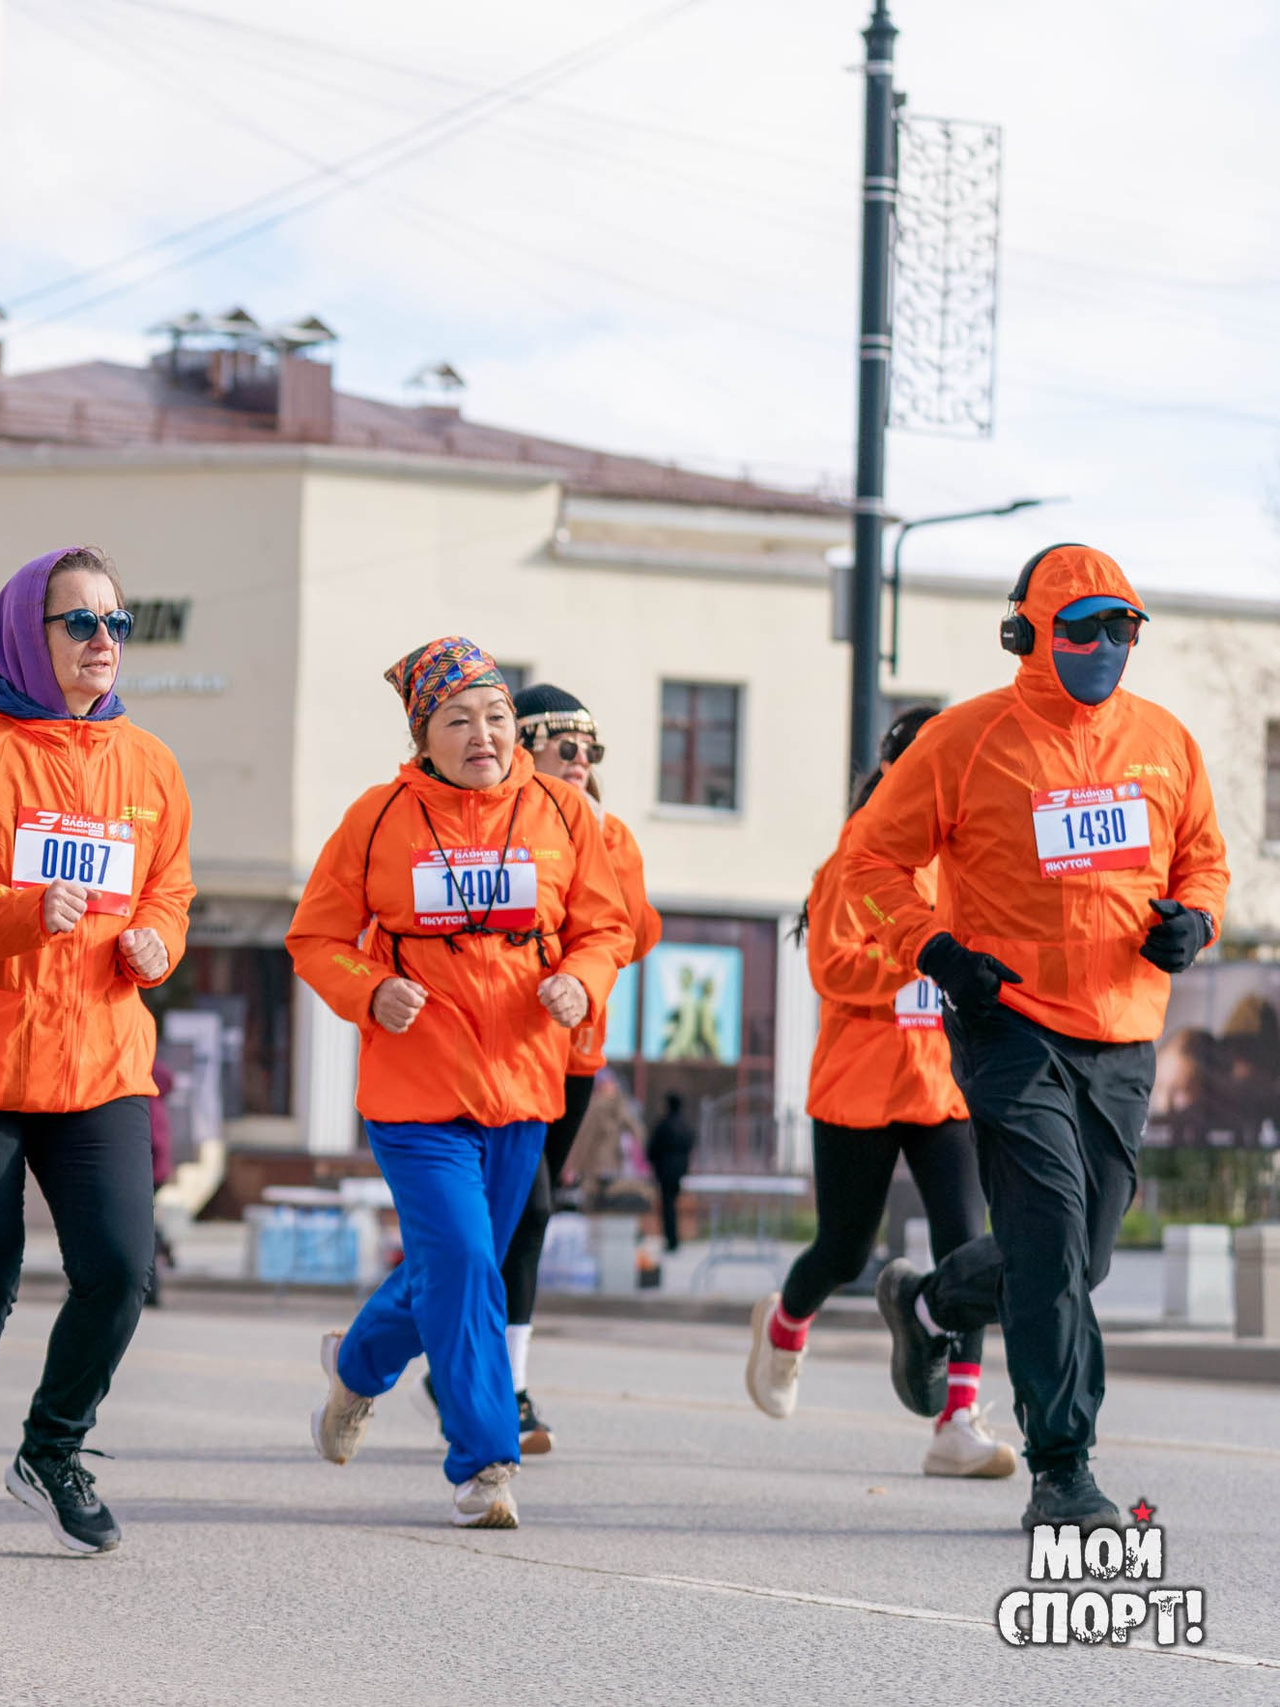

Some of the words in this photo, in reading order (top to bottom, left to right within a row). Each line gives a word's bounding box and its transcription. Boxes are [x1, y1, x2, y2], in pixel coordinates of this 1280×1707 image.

[1062, 807, 1127, 849] 1430
[41, 838, 111, 885] 0087
[1045, 858, 1092, 872] ЯКУТСК
[442, 869, 510, 906] 1400
[420, 915, 467, 926] ЯКУТСК
